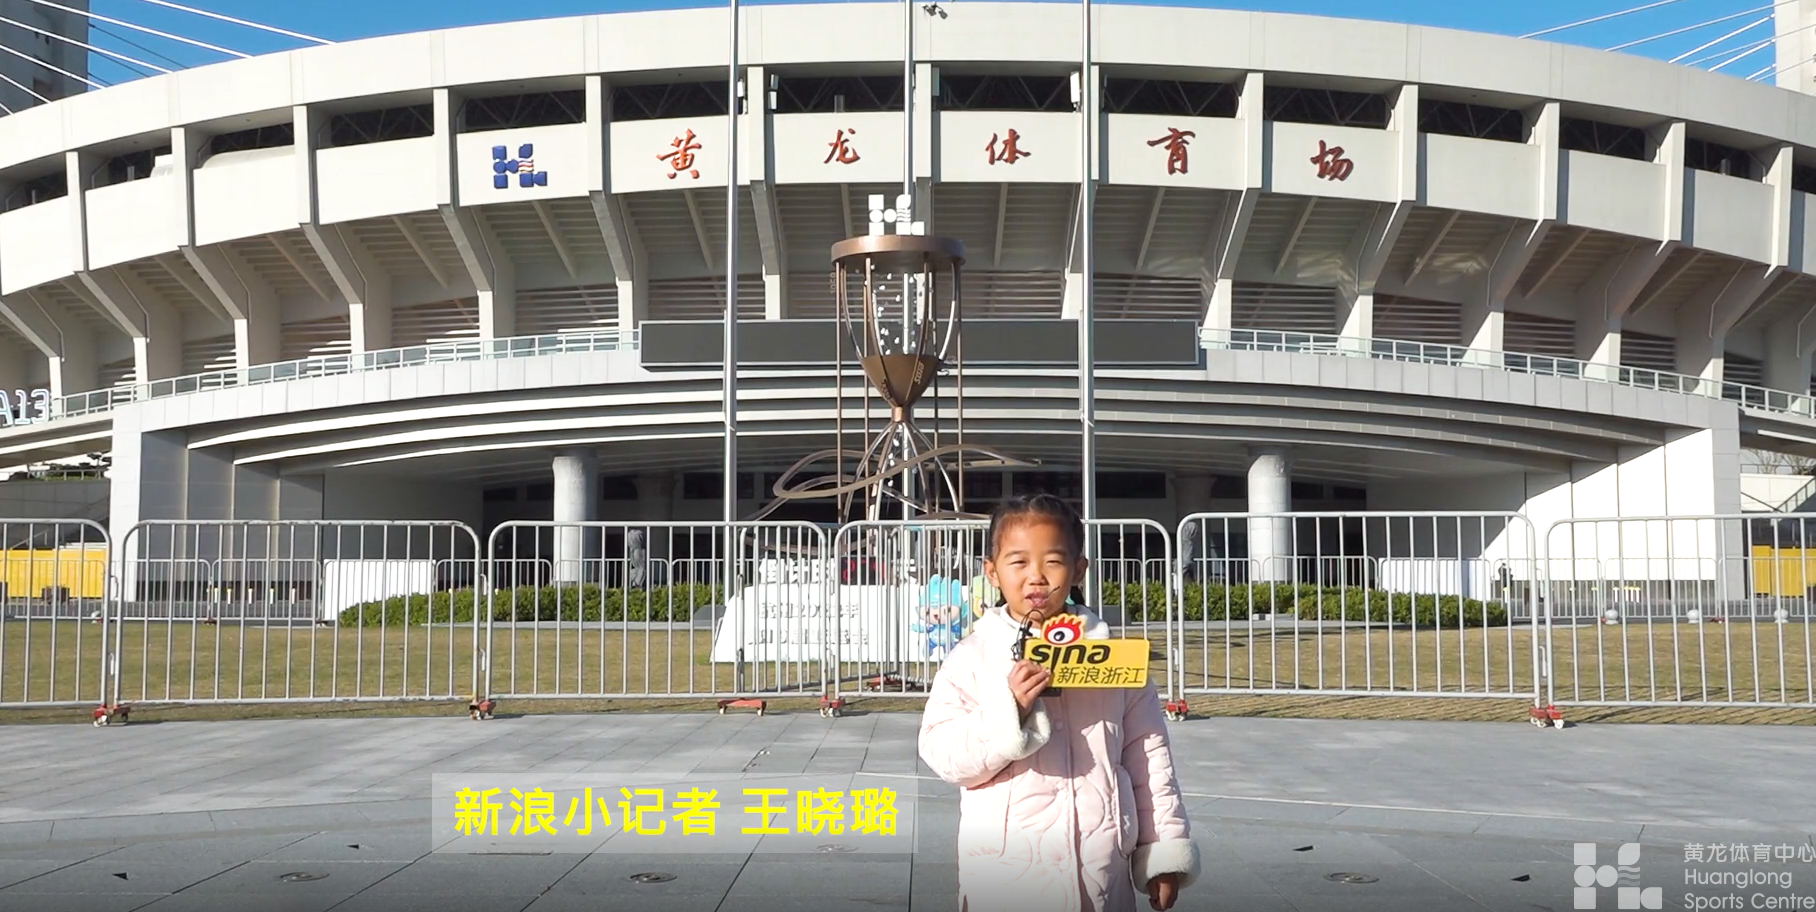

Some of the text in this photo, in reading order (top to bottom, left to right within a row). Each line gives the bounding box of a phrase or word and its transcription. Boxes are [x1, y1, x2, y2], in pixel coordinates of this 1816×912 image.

[655, 126, 1355, 182] 黄龙体育场
[1057, 666, 1145, 685] 新浪浙江
